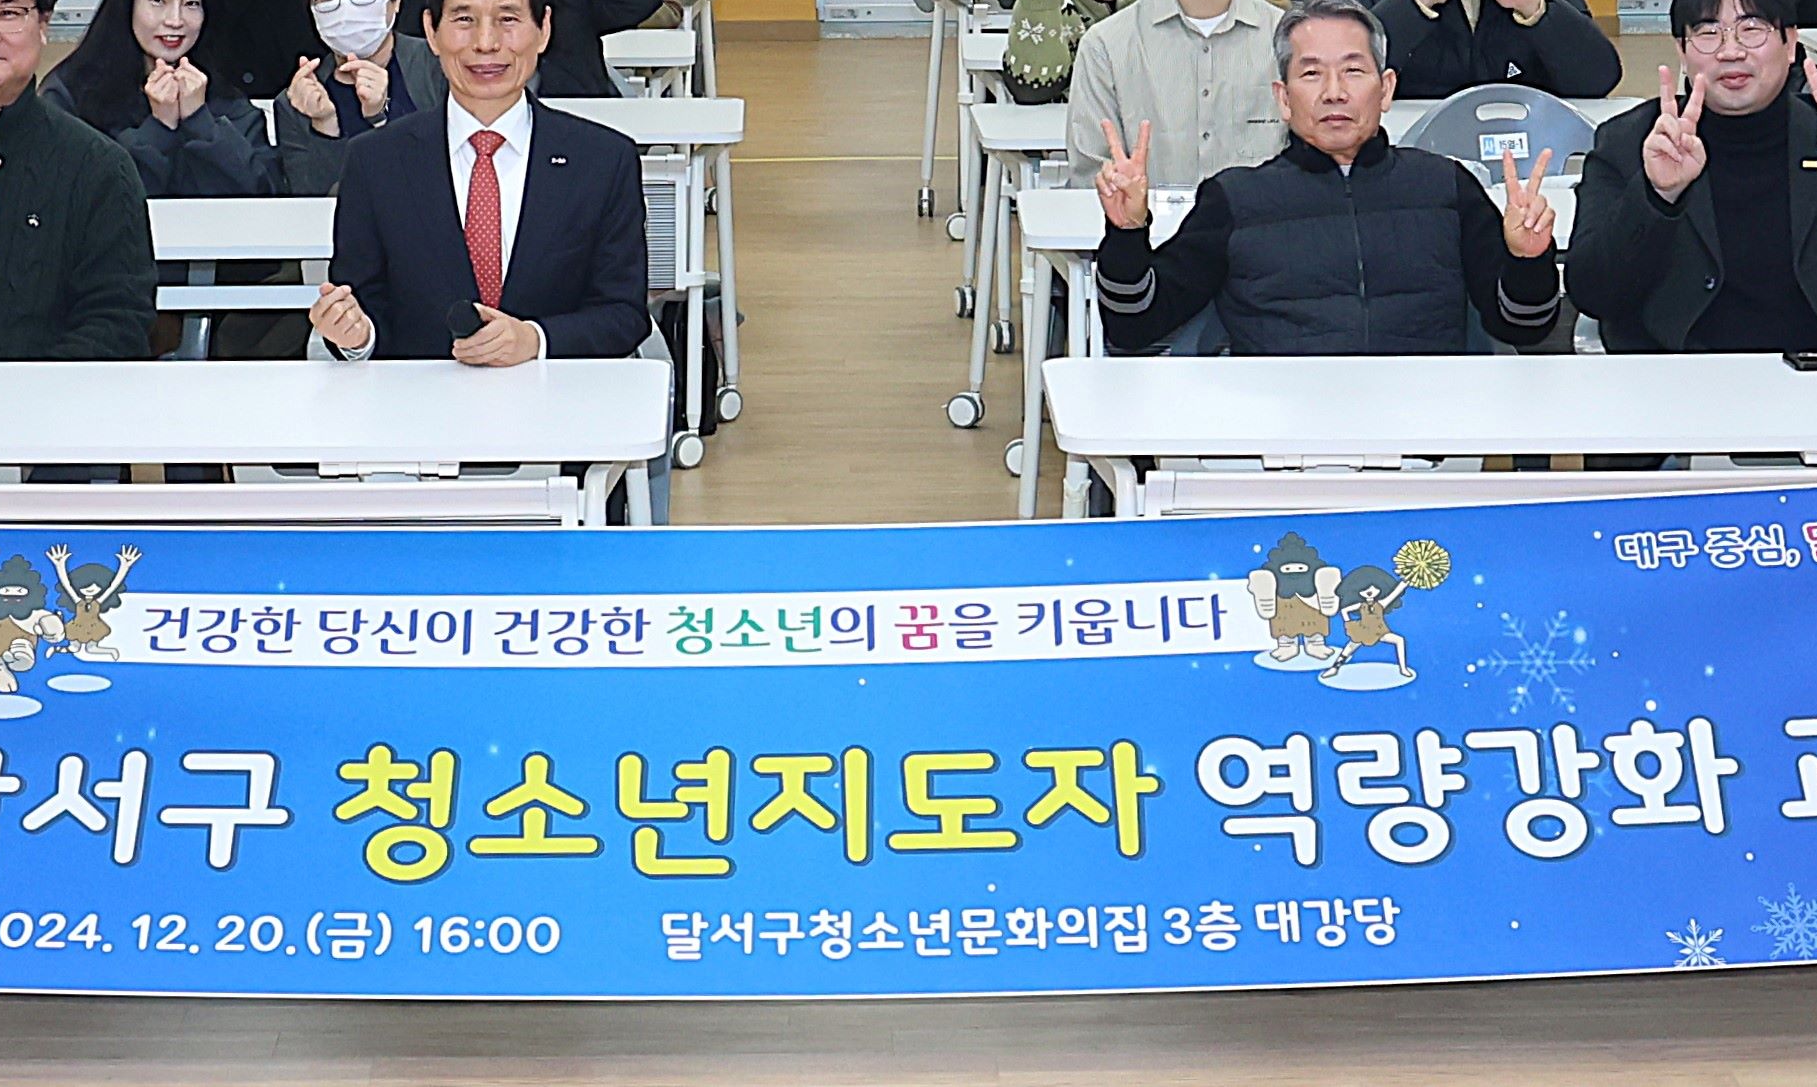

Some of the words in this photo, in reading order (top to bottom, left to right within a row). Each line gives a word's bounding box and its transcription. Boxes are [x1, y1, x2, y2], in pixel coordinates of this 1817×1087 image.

[1615, 529, 1699, 569] 대구
[1703, 523, 1802, 568] 중심,
[142, 606, 302, 655] 건강한
[318, 607, 473, 656] 당신이
[494, 606, 651, 656] 건강한
[666, 604, 876, 655] 청소년의
[894, 602, 999, 651] 꿈을
[1017, 593, 1228, 647] 키웁니다
[332, 740, 1163, 882] 청소년지도자
[1196, 716, 1741, 866] 역량강화
[131, 914, 201, 955] 12.
[413, 915, 562, 955] 16:00
[661, 903, 1149, 961] 달서구청소년문화의집
[1162, 900, 1243, 952] 3층
[1254, 896, 1402, 948] 대강당
